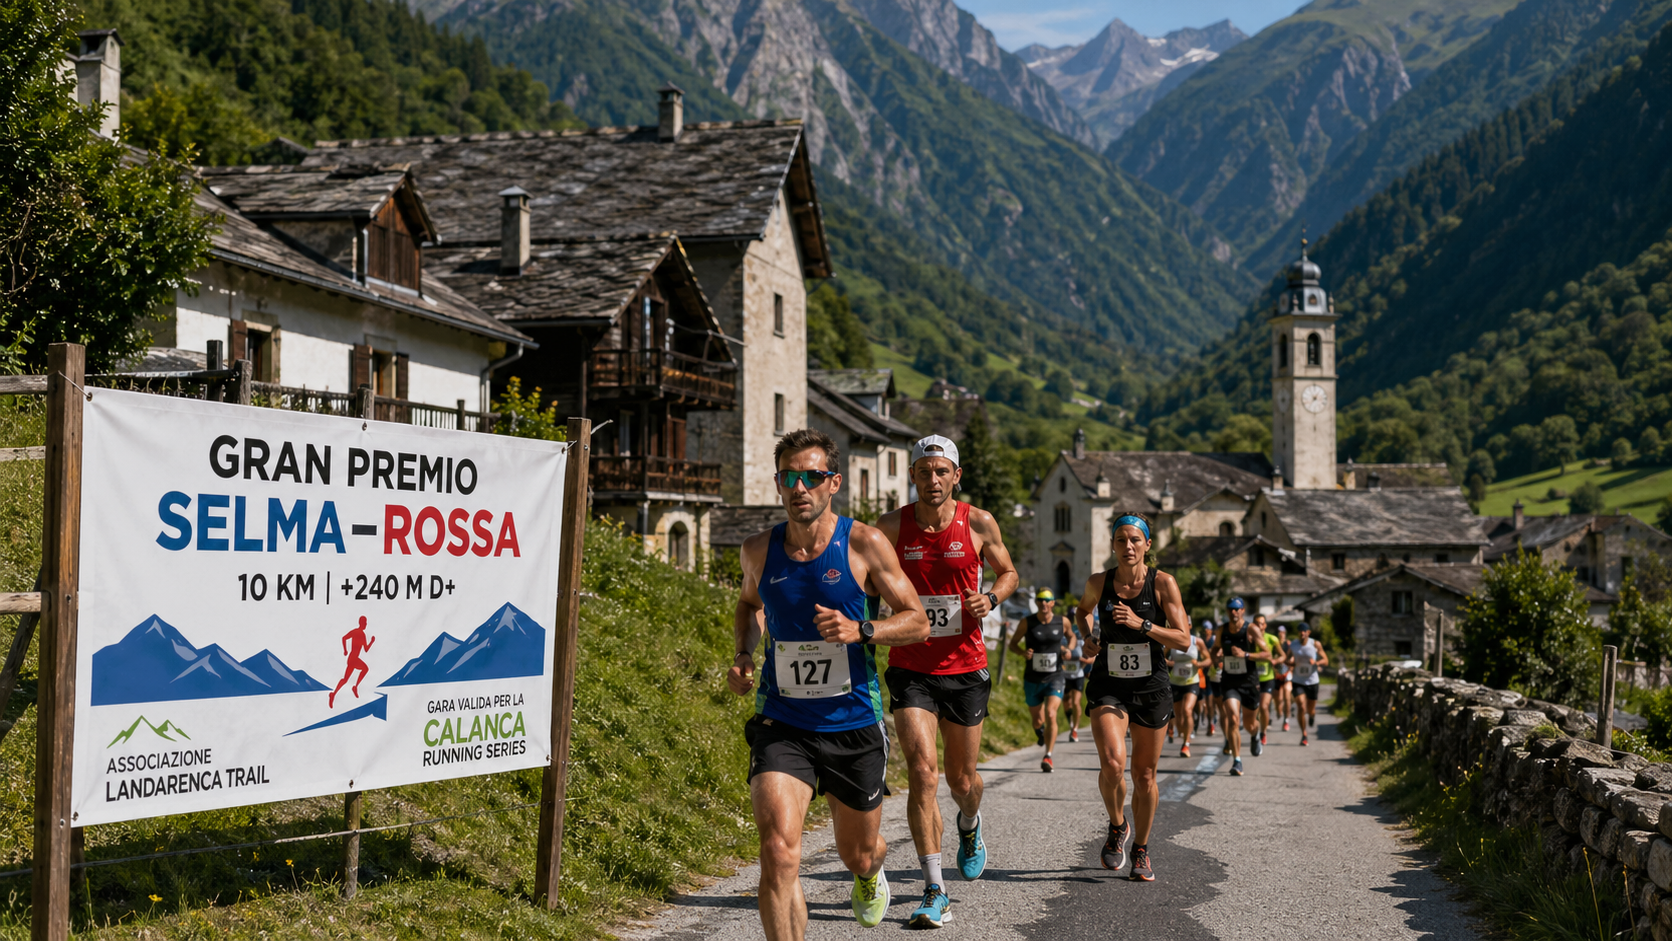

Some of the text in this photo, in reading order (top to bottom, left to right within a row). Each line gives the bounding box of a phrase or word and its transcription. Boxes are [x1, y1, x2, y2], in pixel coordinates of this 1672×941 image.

[209, 434, 478, 496] GRAN PREMIO
[237, 573, 268, 602] 10
[276, 573, 315, 601] KM
[340, 574, 400, 601] +240
[406, 574, 423, 600] M
[429, 574, 456, 600] D+
[789, 658, 832, 686] 127
[1120, 654, 1139, 670] 83
[427, 693, 525, 714] GARA VALIDA PER LA
[423, 711, 526, 748] CALANCA
[105, 748, 212, 775] ASSOCIAZIONE
[422, 739, 526, 767] RUNNING SERIES
[105, 764, 270, 803] LANDARENCA TRAIL
